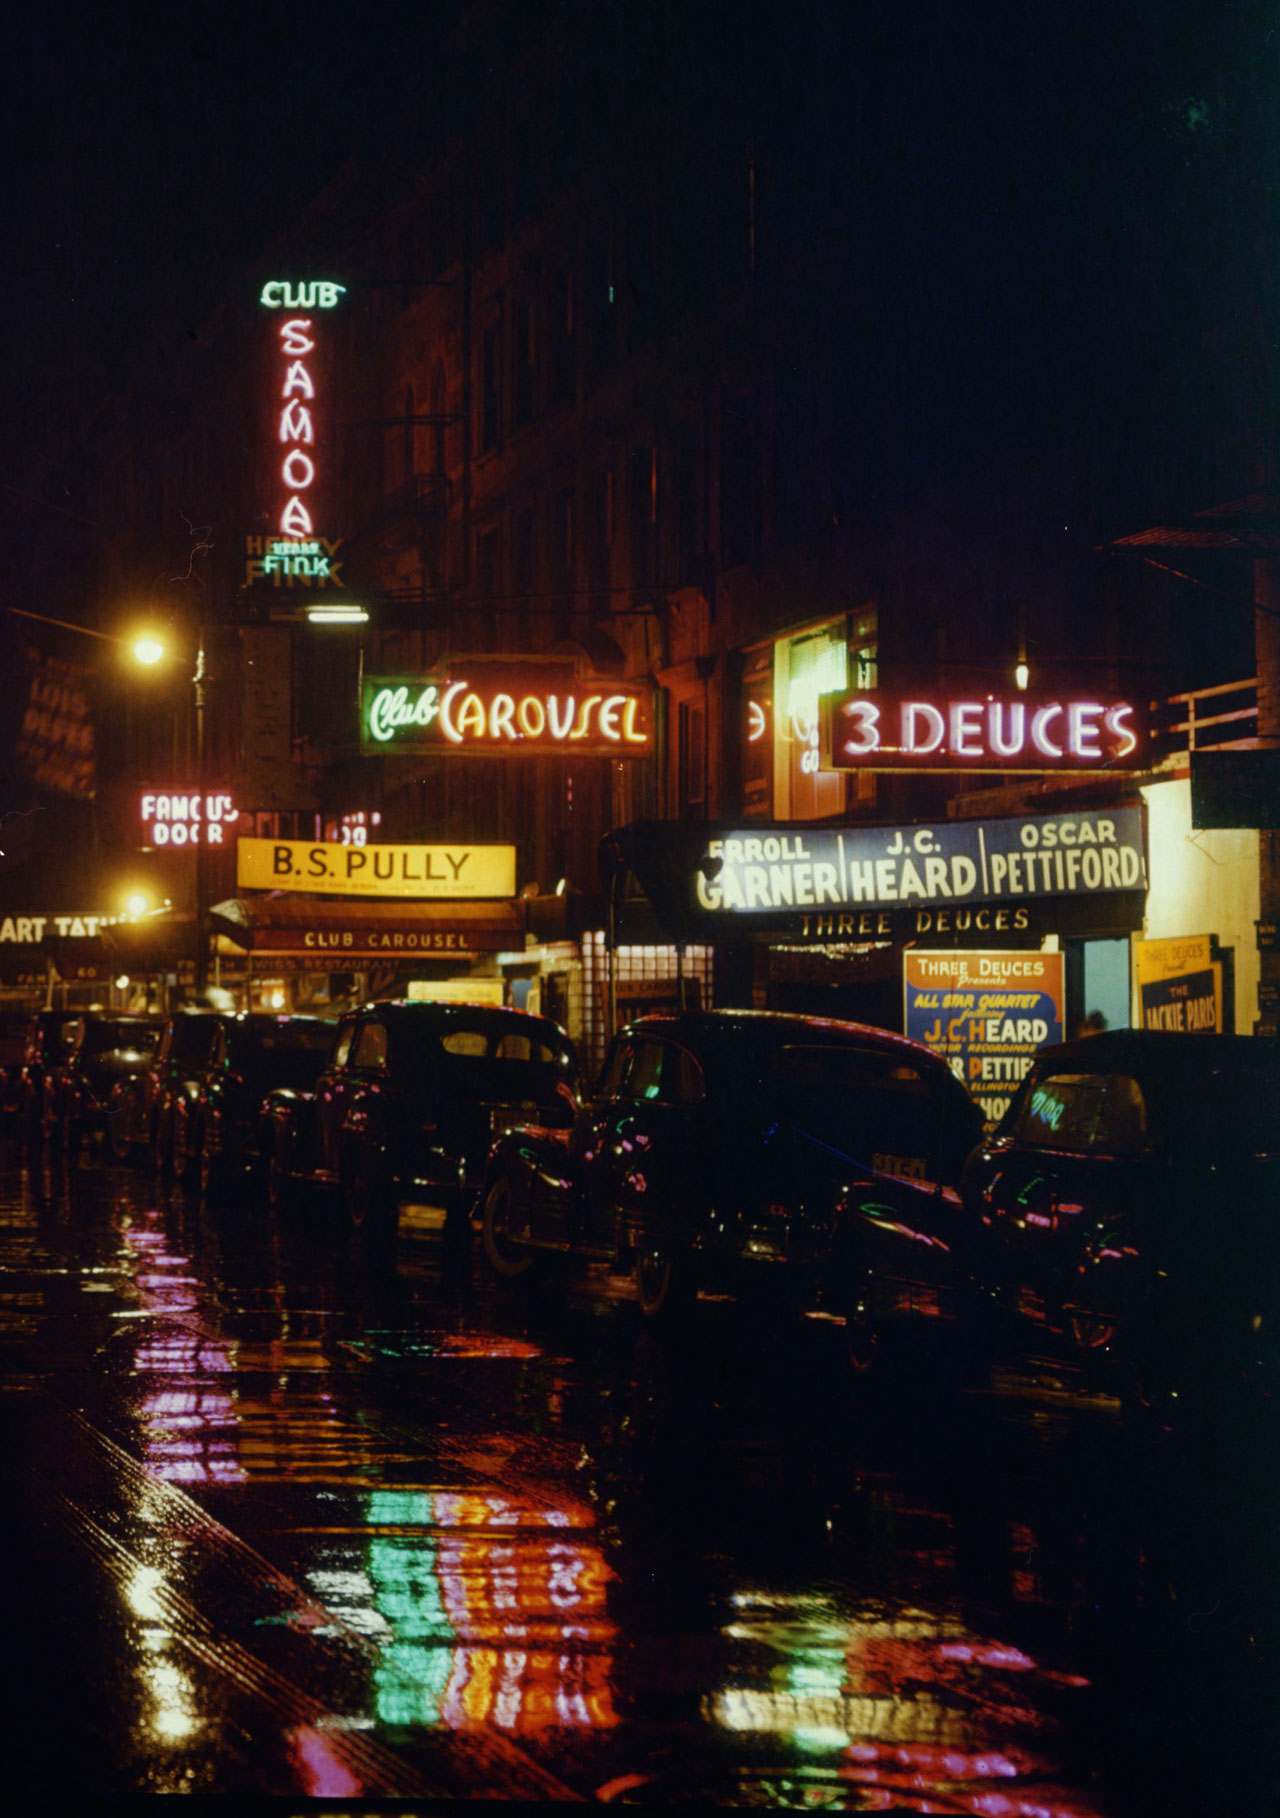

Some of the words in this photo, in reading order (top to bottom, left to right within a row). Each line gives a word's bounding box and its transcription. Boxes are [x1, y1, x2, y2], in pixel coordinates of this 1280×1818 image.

[260, 280, 347, 308] CLUB
[279, 319, 315, 537] SAMOA
[370, 685, 440, 741] Club
[439, 681, 648, 743] CAROUSEL
[844, 700, 881, 757] 3
[900, 701, 1138, 758] DEUCES
[709, 836, 811, 863] ERROLL
[886, 831, 942, 856] J.C.
[1020, 818, 1118, 848] OSCAR
[273, 845, 335, 878] B.S.
[346, 850, 472, 882] PULLY
[696, 861, 841, 911] GARNER
[850, 855, 977, 902] HEARD
[991, 844, 1140, 895] PETTIFORD
[800, 912, 892, 937] THREE
[916, 908, 1030, 933] DEUCES
[304, 931, 354, 947] CLUB
[367, 932, 469, 949] CAROUSEL
[917, 958, 969, 976] THREE
[979, 958, 1045, 976] DEUCES
[913, 994, 941, 1009] ALL
[941, 993, 976, 1009] STAR
[978, 994, 1042, 1009] QUARTET
[924, 1018, 967, 1043] J.C.
[969, 1018, 1049, 1043] HEARD
[969, 1056, 1035, 1081] PETTIF
